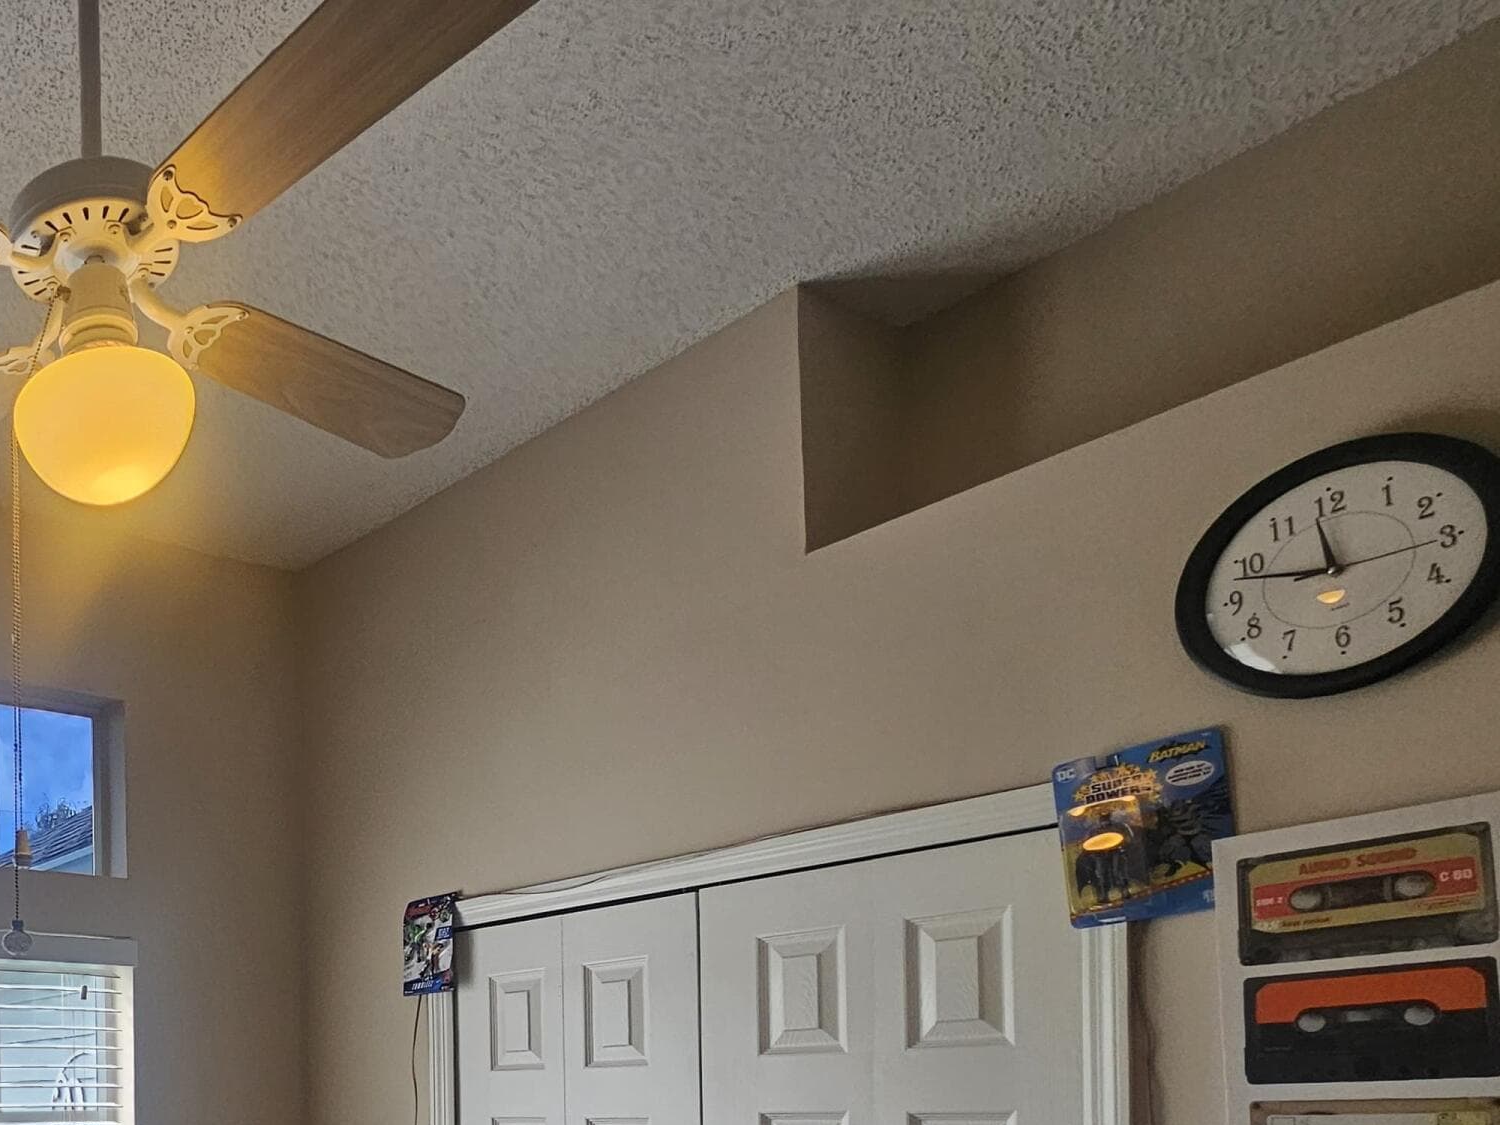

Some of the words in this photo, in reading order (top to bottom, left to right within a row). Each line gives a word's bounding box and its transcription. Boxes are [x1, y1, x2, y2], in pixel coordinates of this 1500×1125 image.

[1314, 490, 1347, 519] 12
[1381, 483, 1394, 507] 1
[1417, 496, 1435, 520] 2
[1268, 516, 1297, 542] 11
[1439, 524, 1458, 549] 3
[1237, 552, 1264, 578] 10
[1426, 562, 1445, 585] 4
[1228, 590, 1244, 616] 9
[1387, 598, 1405, 624] 5
[1246, 613, 1263, 639] 8
[1334, 625, 1351, 649] 6
[1281, 629, 1297, 652] 7
[1148, 741, 1207, 763] BATMAN
[1056, 767, 1076, 782] DC
